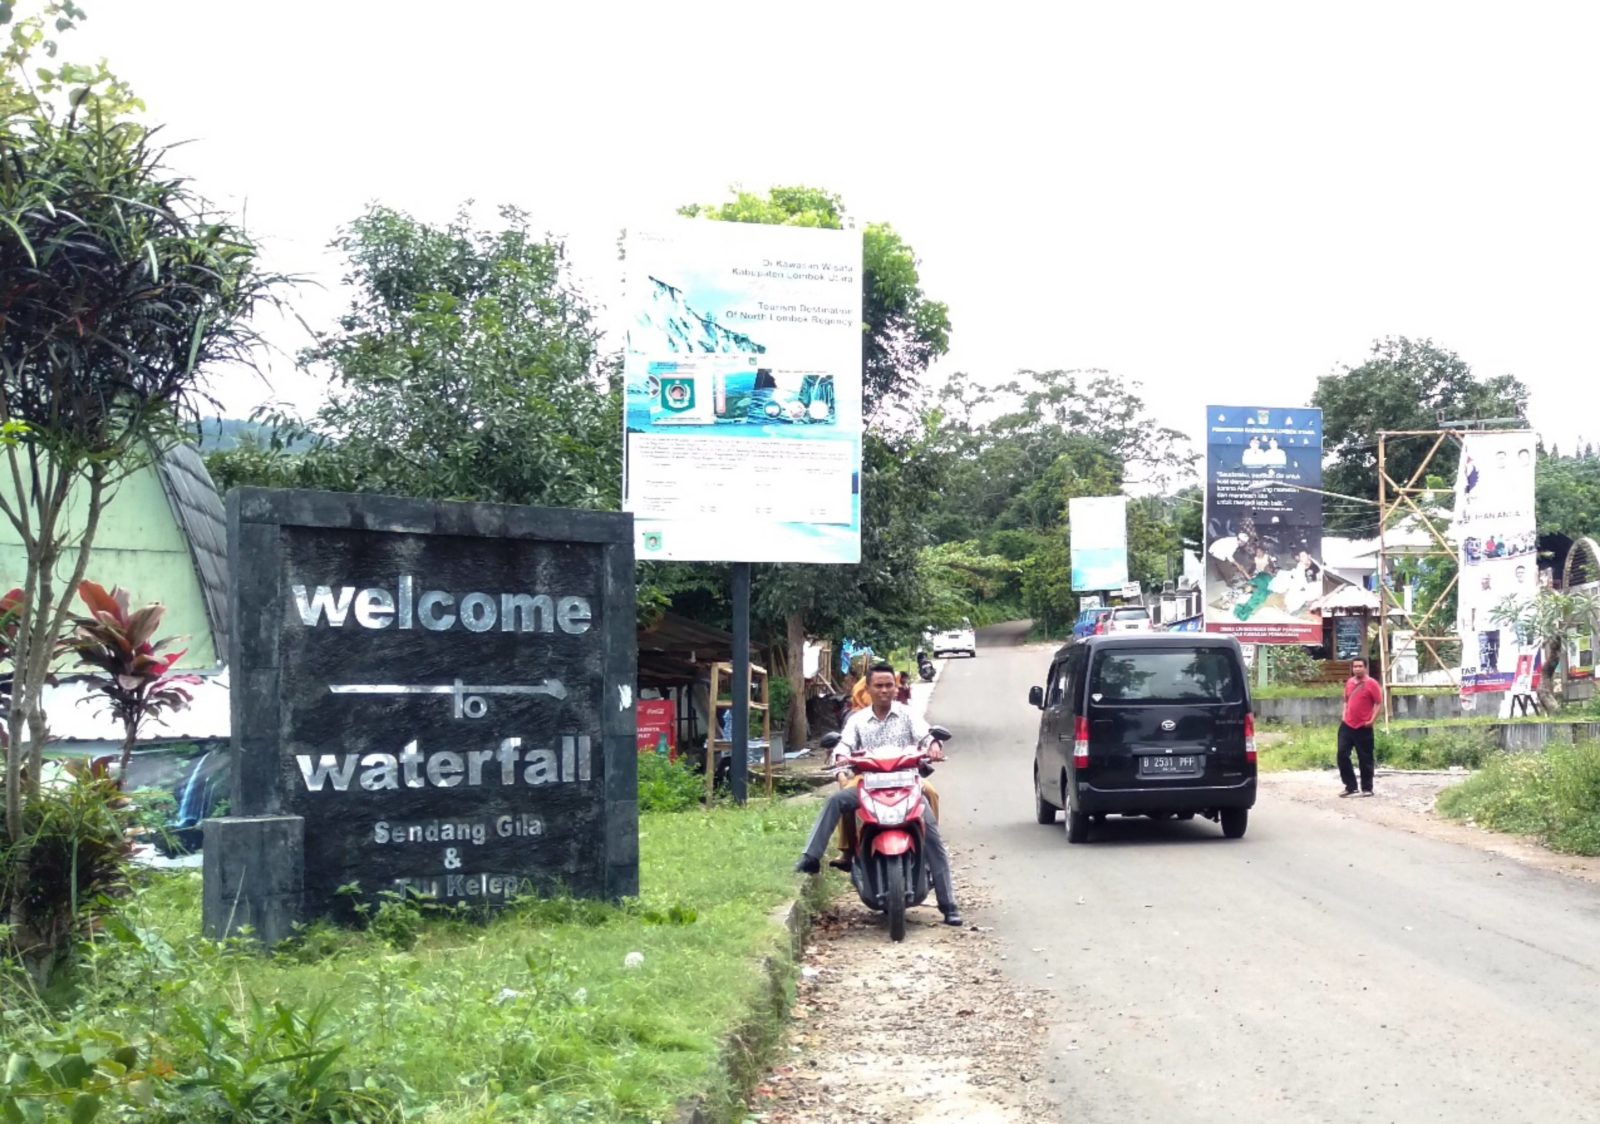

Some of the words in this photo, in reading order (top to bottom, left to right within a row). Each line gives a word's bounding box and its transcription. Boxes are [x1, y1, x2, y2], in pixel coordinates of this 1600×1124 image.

[732, 267, 784, 278] Kabupaten
[787, 270, 824, 280] Lombok
[726, 310, 737, 319] Of
[740, 311, 766, 321] North
[770, 313, 808, 323] Lombok
[811, 316, 853, 327] Regency
[758, 301, 796, 312] Tourism
[800, 304, 853, 315] Destination
[291, 574, 592, 634] welcome
[453, 678, 488, 719] to
[295, 735, 592, 792] waterfall
[374, 819, 486, 845] Sendang
[496, 813, 542, 838] Gila
[443, 847, 462, 869] &
